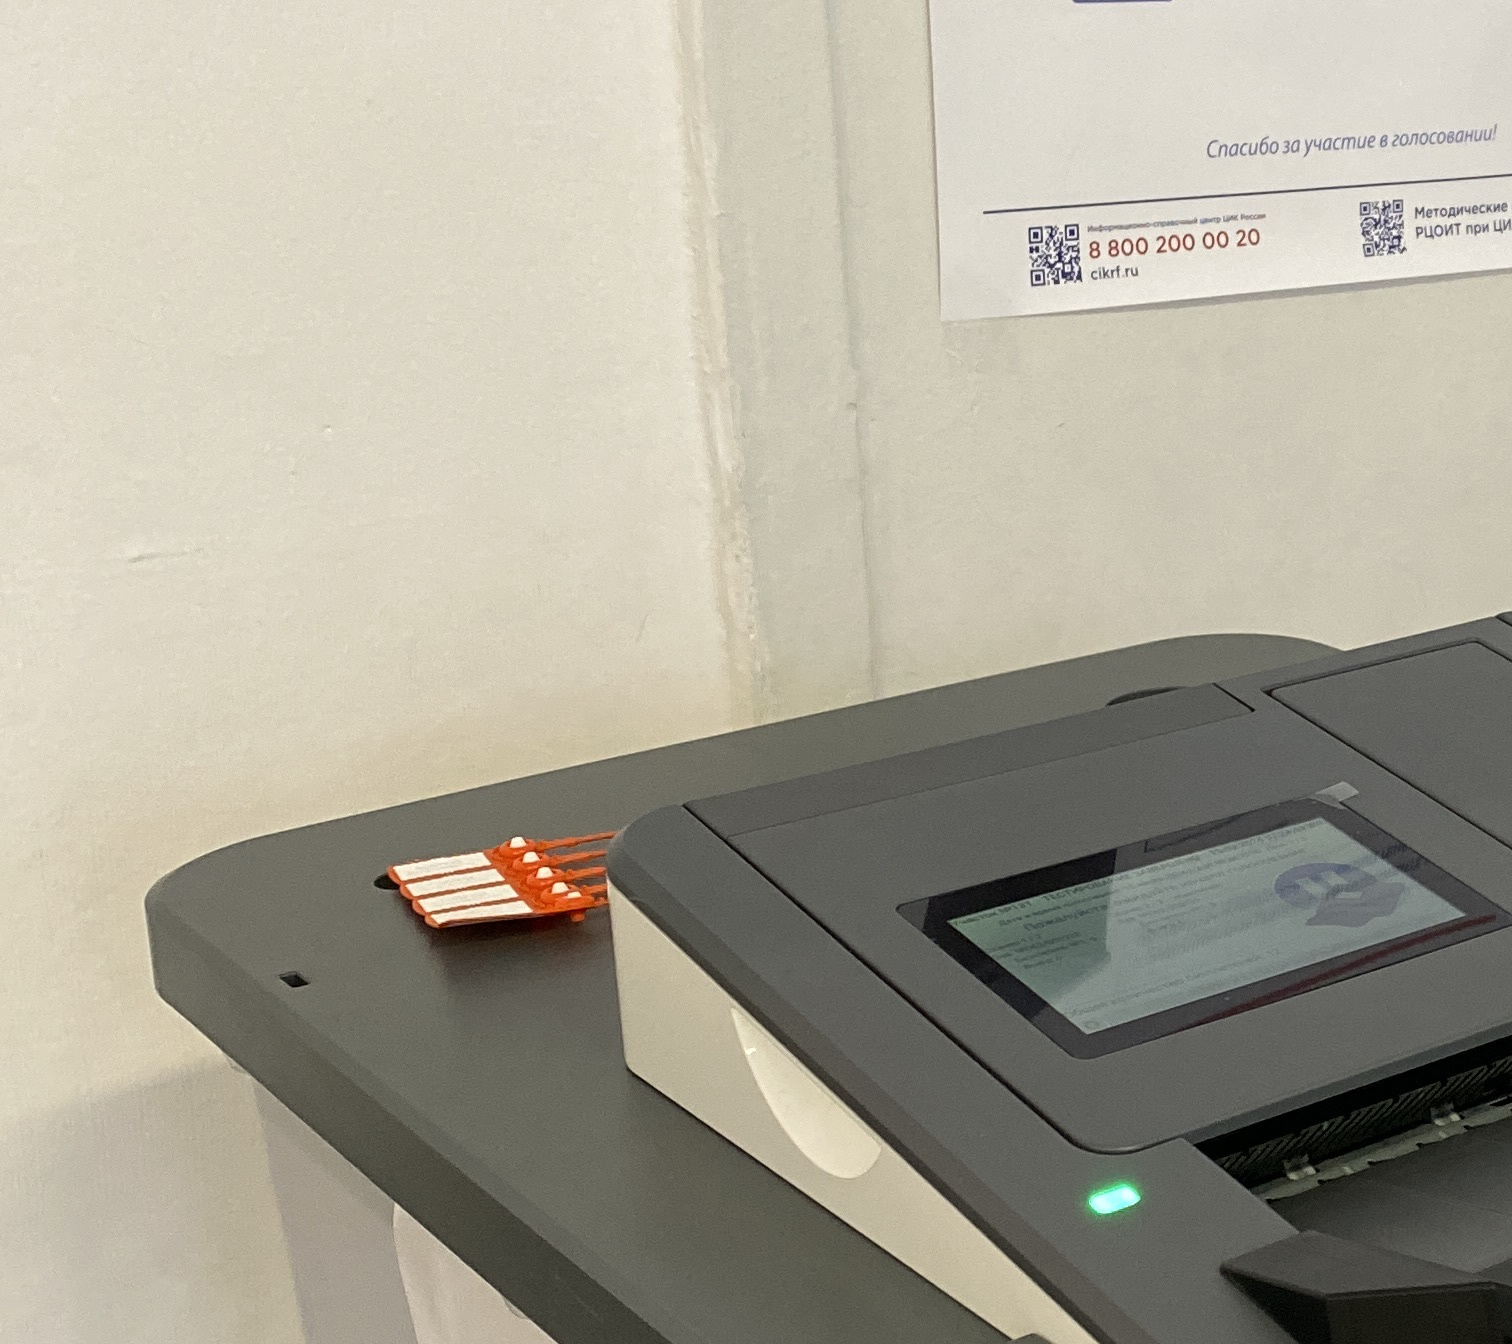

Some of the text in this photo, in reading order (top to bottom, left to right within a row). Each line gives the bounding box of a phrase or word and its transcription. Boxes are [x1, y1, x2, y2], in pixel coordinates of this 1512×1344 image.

[1206, 124, 1498, 159] Спасибо за участие в голосовании!
[1414, 199, 1508, 220] Методические
[1415, 222, 1462, 241] РЦОИТ
[1465, 221, 1489, 237] при
[1089, 228, 1260, 259] 8 800 200 00 20
[1090, 265, 1139, 281] cikrf.ru
